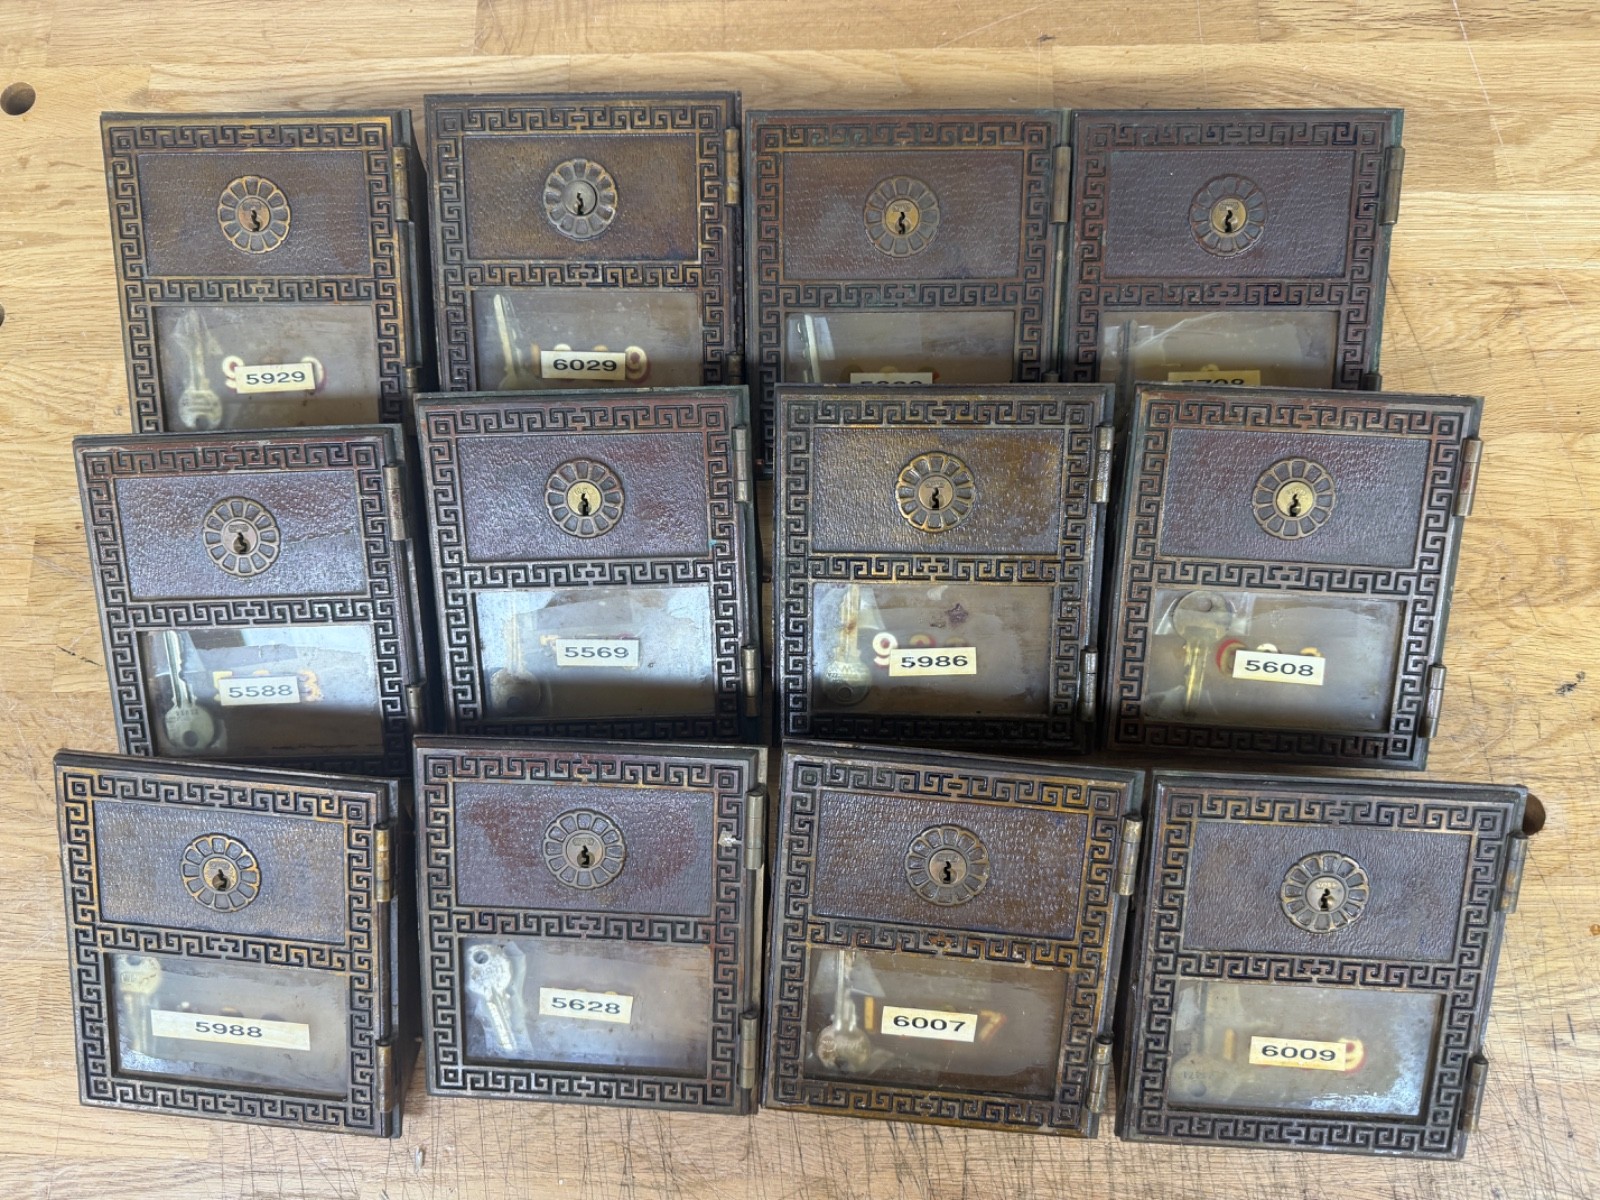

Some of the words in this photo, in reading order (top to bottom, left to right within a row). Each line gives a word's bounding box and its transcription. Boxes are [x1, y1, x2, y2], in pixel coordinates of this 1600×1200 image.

[553, 359, 618, 372] 6029
[246, 371, 306, 385] 5929
[564, 646, 629, 659] 5569
[901, 655, 969, 668] 5986
[1245, 659, 1314, 677] 5608
[229, 684, 293, 698] 5588
[551, 997, 621, 1015] 5628
[195, 1021, 263, 1038] 5988
[893, 1015, 966, 1032] 6007
[1261, 1044, 1336, 1062] 6009
